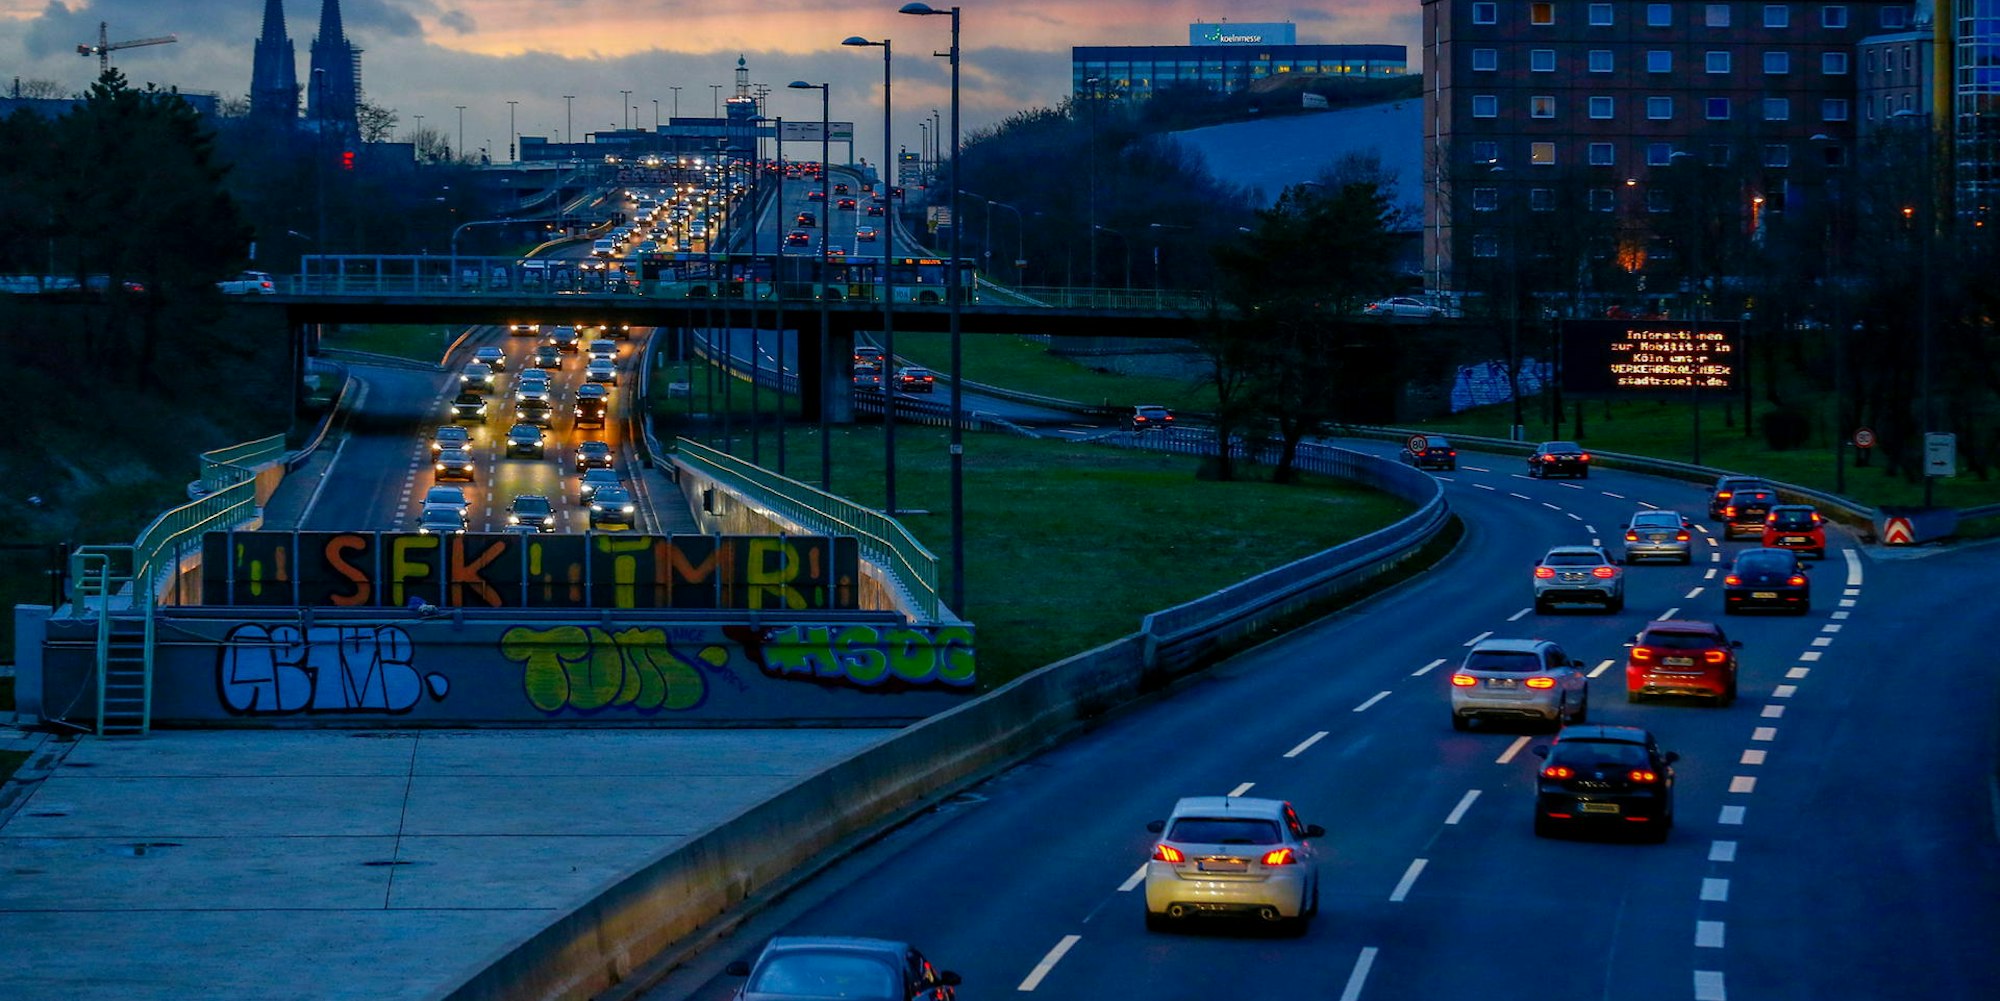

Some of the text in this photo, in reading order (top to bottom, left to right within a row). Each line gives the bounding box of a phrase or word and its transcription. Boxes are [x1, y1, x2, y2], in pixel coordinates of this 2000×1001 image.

[1220, 33, 1262, 43] koelnmesse
[1611, 343, 1634, 351] zur
[1715, 342, 1731, 352] in
[1633, 354, 1709, 363] Köln untr
[1412, 439, 1424, 450] 80
